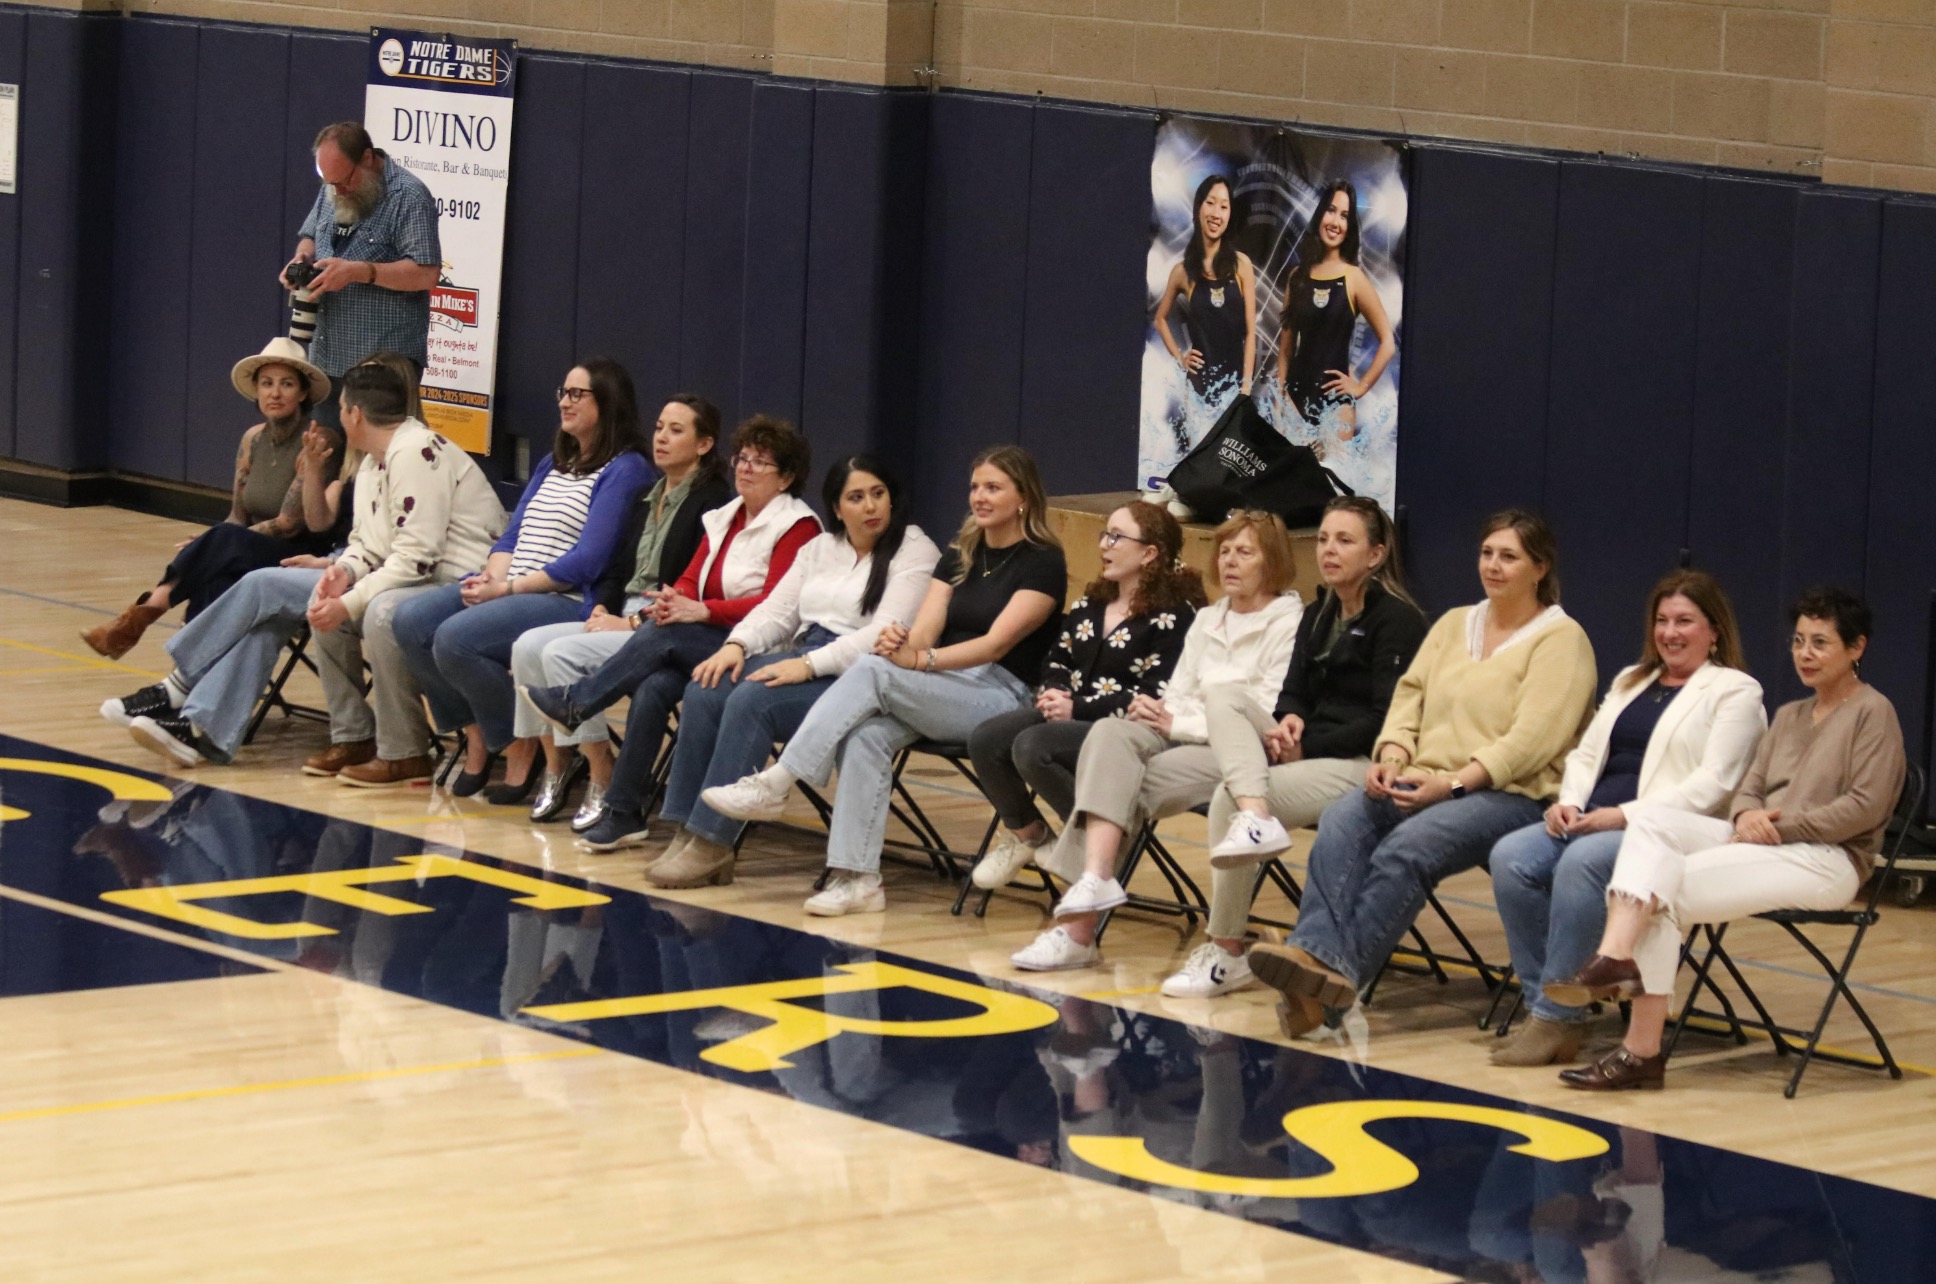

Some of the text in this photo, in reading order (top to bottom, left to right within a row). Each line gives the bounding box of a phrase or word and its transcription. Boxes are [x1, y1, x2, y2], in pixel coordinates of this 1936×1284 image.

[410, 41, 492, 64] NOTRE DAME
[408, 59, 492, 81] TIGERS
[392, 107, 496, 151] DIVINO
[443, 161, 459, 174] Bar
[461, 163, 470, 175] &
[437, 198, 480, 220] 0-9102
[430, 295, 441, 308] IN
[430, 313, 452, 325] ZZA
[433, 354, 446, 363] Real
[452, 356, 480, 367] Belmont
[1218, 446, 1256, 477] SONOMA
[1222, 437, 1267, 471] WILLIAMS
